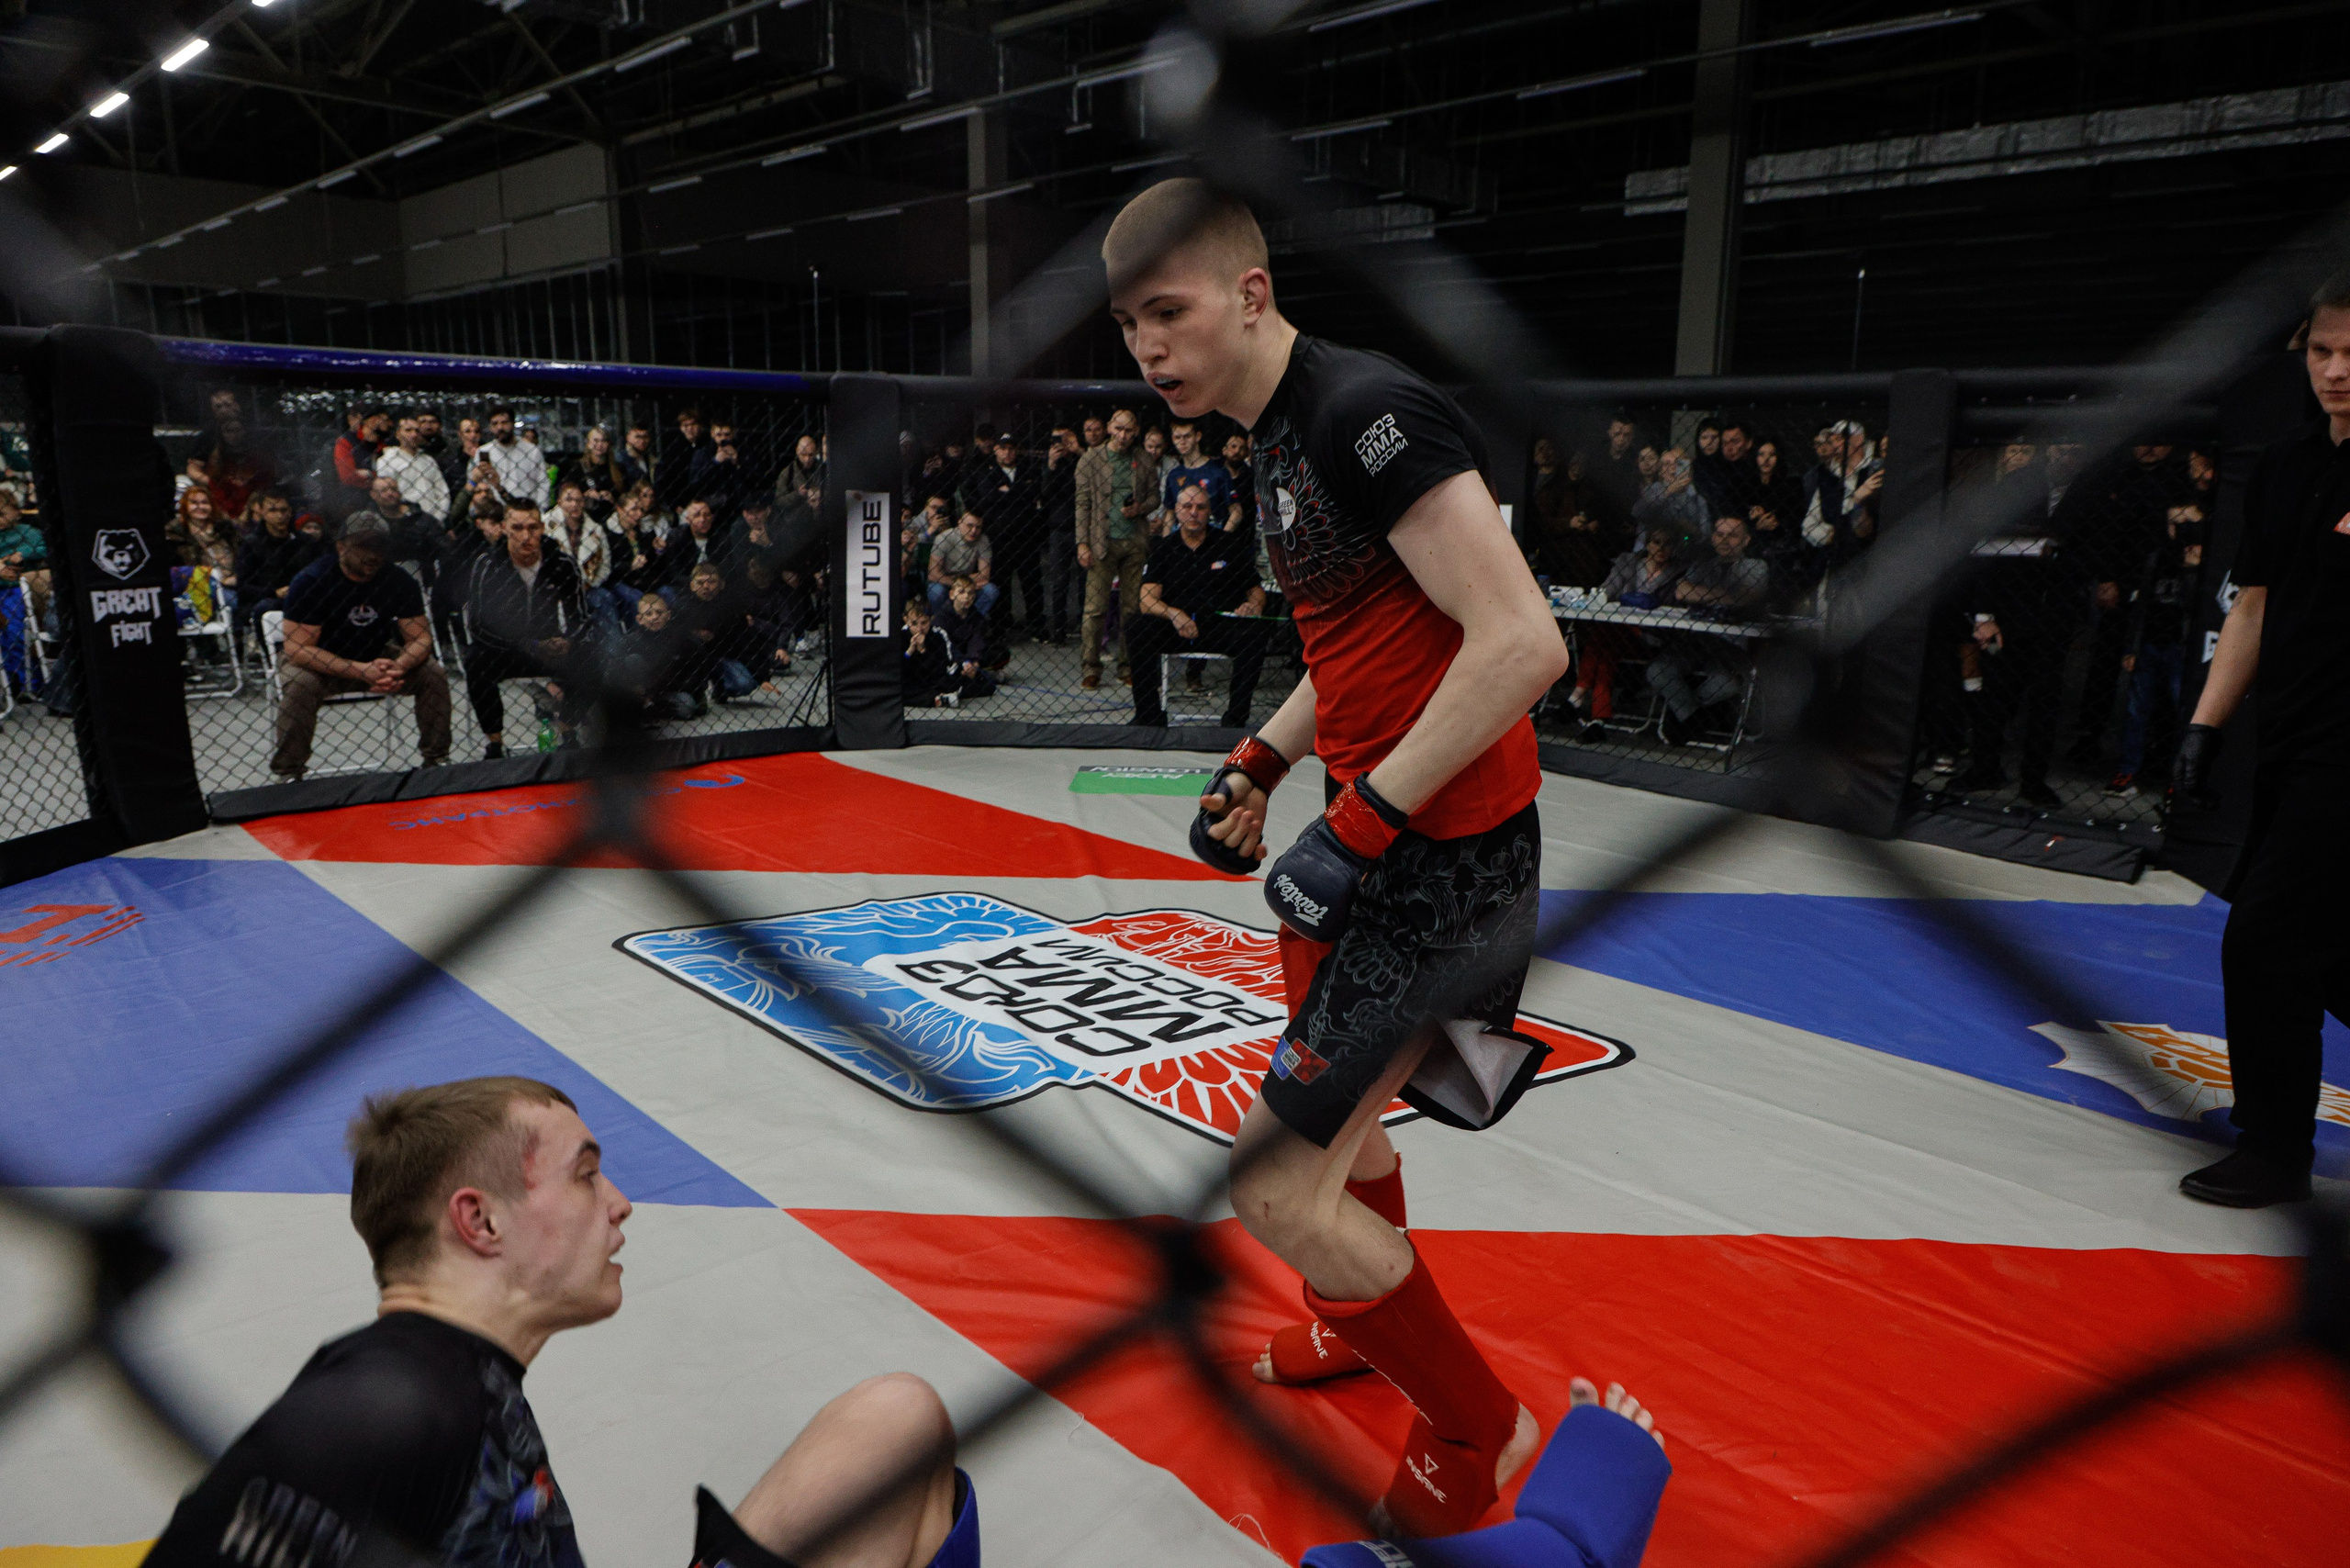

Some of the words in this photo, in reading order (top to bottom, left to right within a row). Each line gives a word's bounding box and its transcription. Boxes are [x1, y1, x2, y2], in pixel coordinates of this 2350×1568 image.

[1354, 413, 1396, 455] СОЮЗ
[1369, 437, 1409, 477] РОССИИ
[862, 500, 881, 635] RUTUBE
[90, 587, 162, 623] GREAT
[1273, 874, 1328, 926] Fairtex
[1031, 938, 1289, 1026] РОССИИ
[896, 960, 1152, 1057] СОЮЗ
